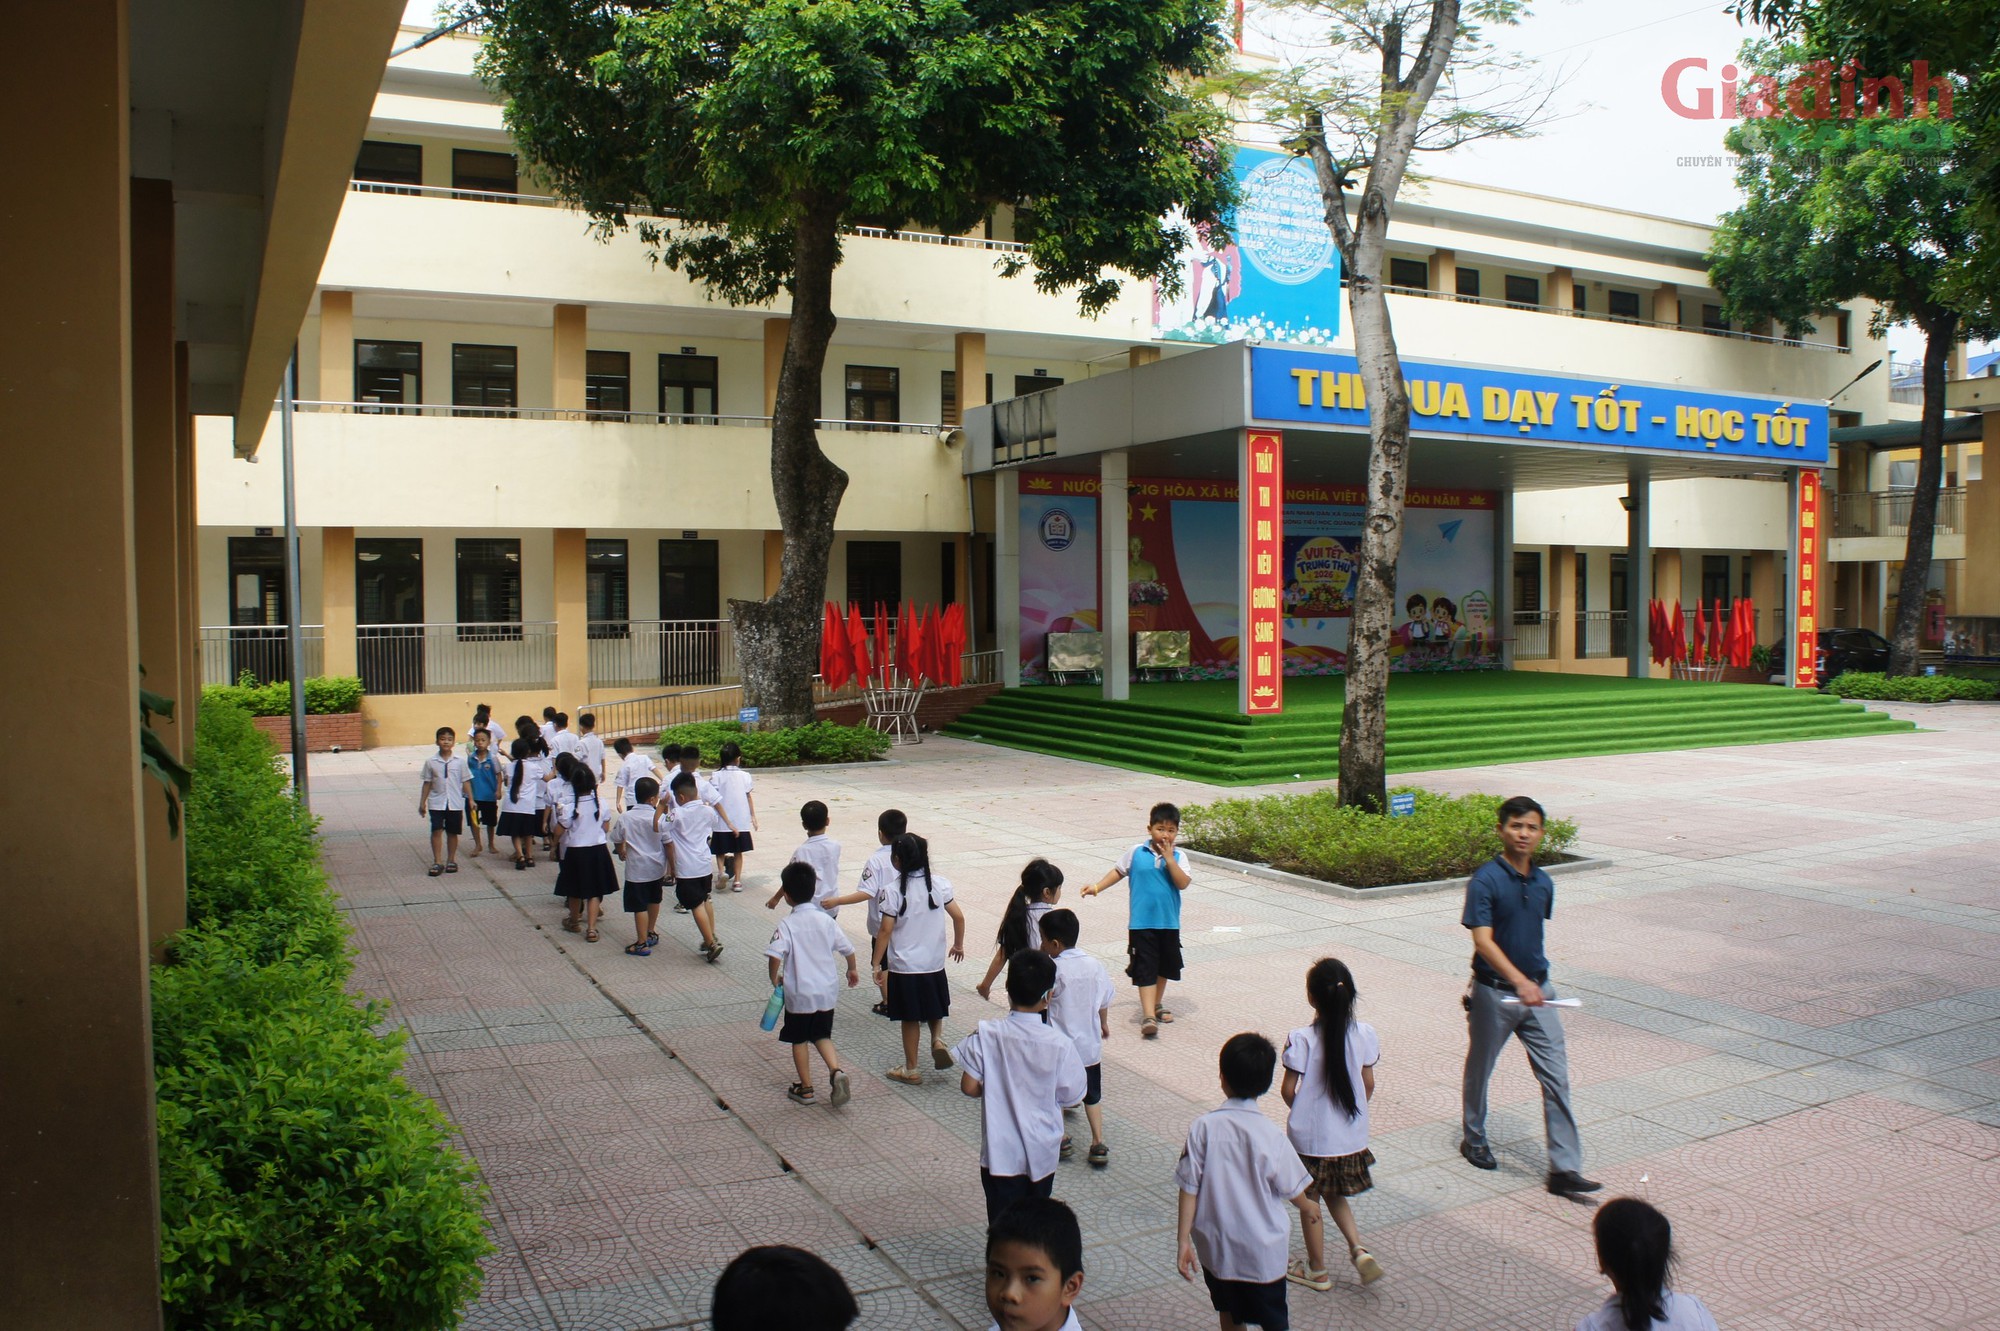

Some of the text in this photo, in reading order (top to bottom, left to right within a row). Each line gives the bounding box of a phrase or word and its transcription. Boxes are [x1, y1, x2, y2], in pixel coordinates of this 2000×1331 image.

[1291, 368, 1366, 410] THI
[1403, 379, 1471, 418] UA
[1483, 385, 1560, 432] DẠY
[1570, 385, 1642, 433] TỐT
[1675, 405, 1745, 448] HỌC
[1752, 402, 1810, 447] TỐT
[1163, 483, 1196, 497] HÒA
[1200, 484, 1220, 498] XÃ
[1286, 488, 1329, 501] NGHĨA
[1332, 490, 1357, 504] VIỆT
[1404, 492, 1431, 505] UÔN
[1304, 545, 1344, 560] VUI TẾT
[1297, 559, 1331, 574] TRUNG
[1255, 617, 1274, 643] SÁNG
